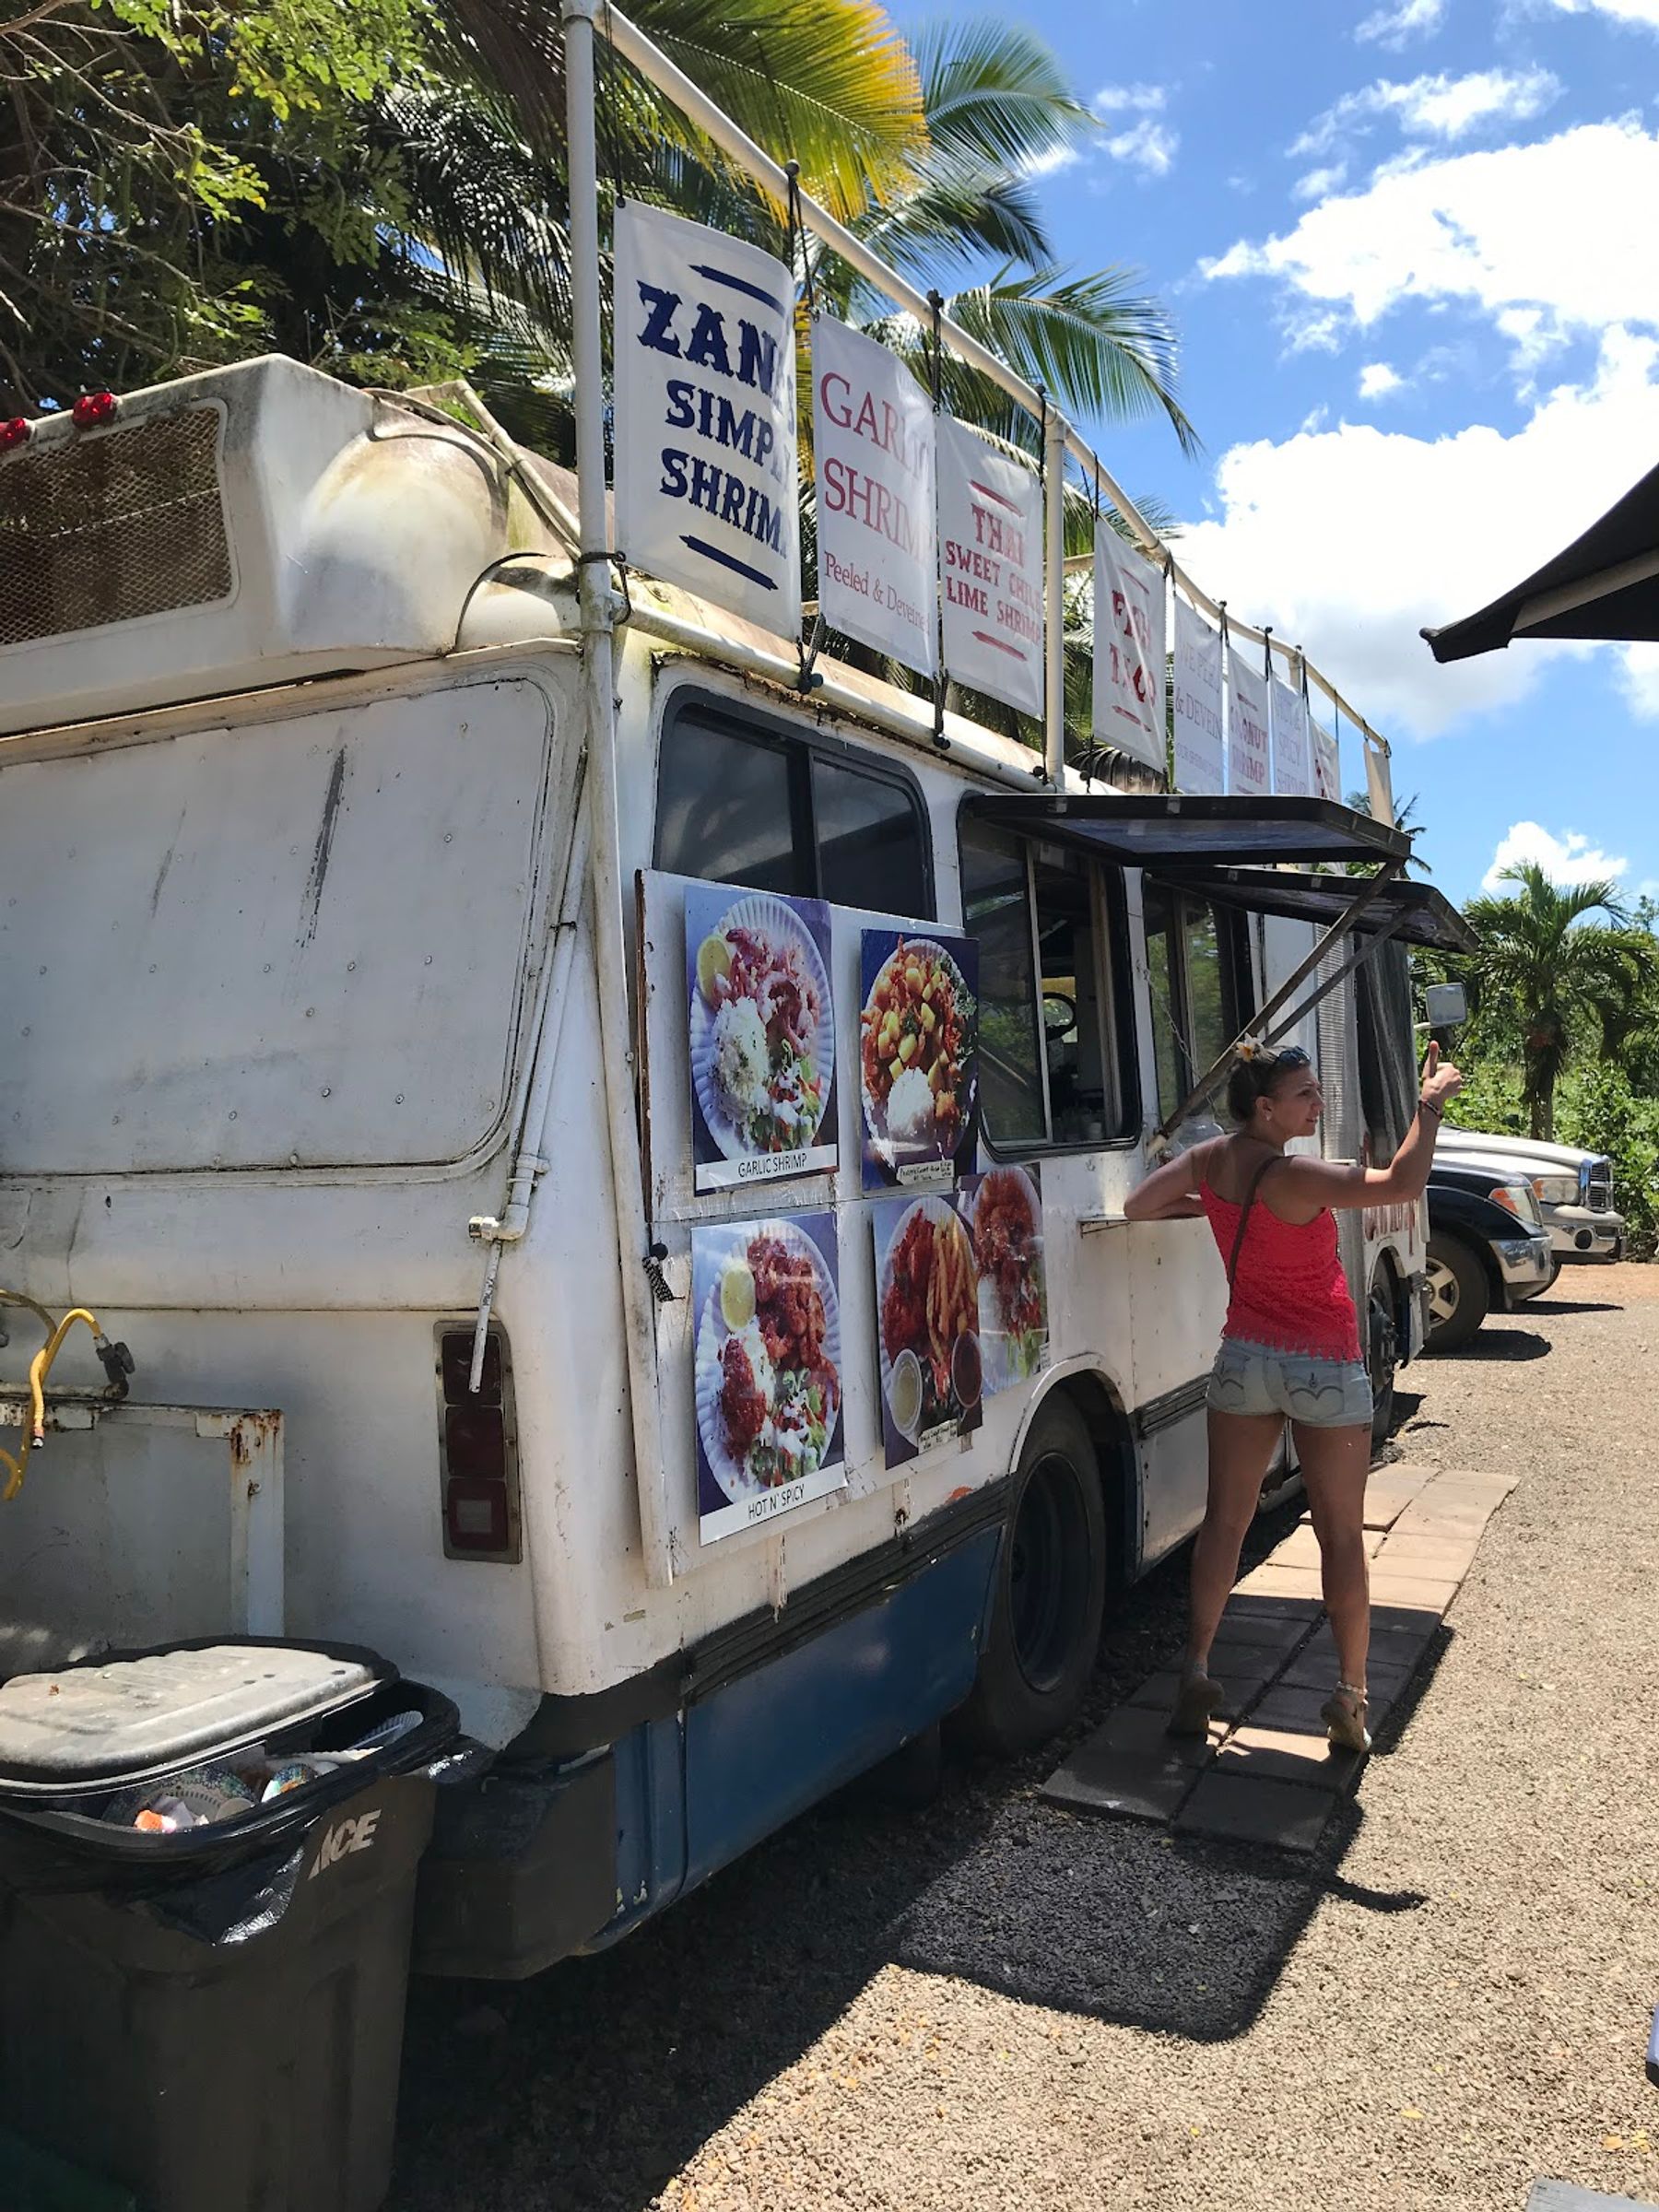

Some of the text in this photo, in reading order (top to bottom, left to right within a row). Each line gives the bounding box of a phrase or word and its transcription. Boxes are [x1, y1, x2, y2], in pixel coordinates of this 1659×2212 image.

[659, 447, 787, 559] SHRIM
[946, 540, 1001, 587] SWEET
[971, 502, 1025, 569] THAI
[824, 550, 869, 596] Peeled
[873, 578, 884, 605] &
[947, 575, 1041, 646] LIME SHRIMP
[738, 1152, 806, 1178] GARLIC SHRIMP
[747, 1499, 768, 1520] HOT
[781, 1484, 804, 1506] SPICY
[307, 1809, 382, 1880] ACE
